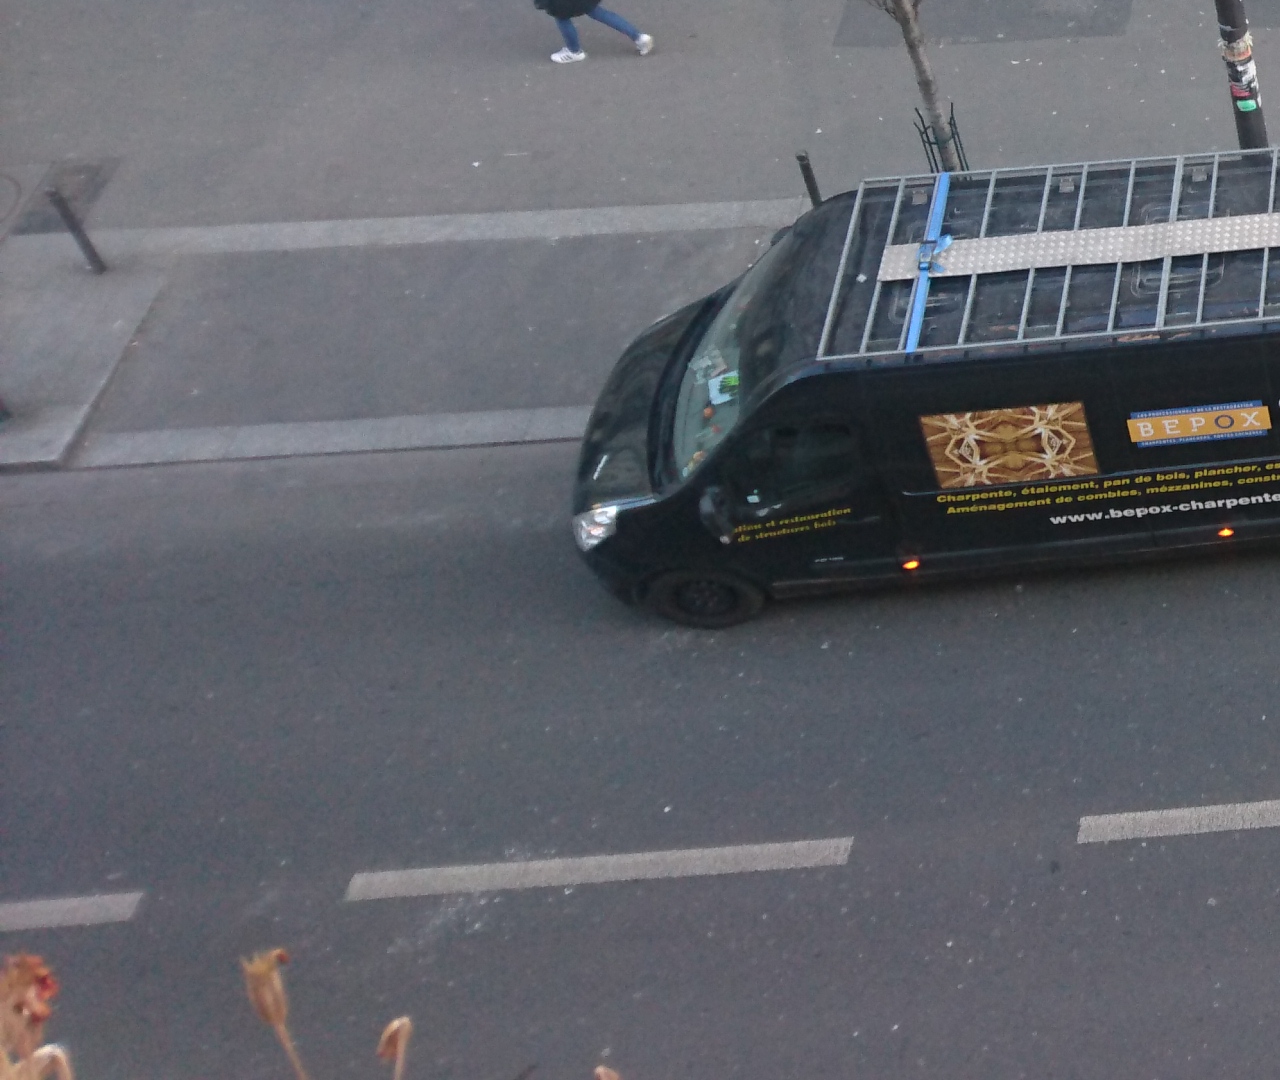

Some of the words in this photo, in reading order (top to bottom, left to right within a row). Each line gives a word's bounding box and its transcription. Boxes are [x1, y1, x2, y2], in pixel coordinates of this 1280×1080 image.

[1137, 411, 1261, 437] BEPOX
[937, 489, 1016, 504] Charpente,
[1103, 477, 1130, 489] pan
[1134, 474, 1152, 484] de
[1156, 470, 1190, 482] bois,
[1194, 463, 1261, 479] plancher,
[946, 496, 1051, 515] Aménagement
[1055, 495, 1073, 505] de
[1077, 489, 1142, 503] combles,
[1146, 479, 1234, 494] mézzanines,
